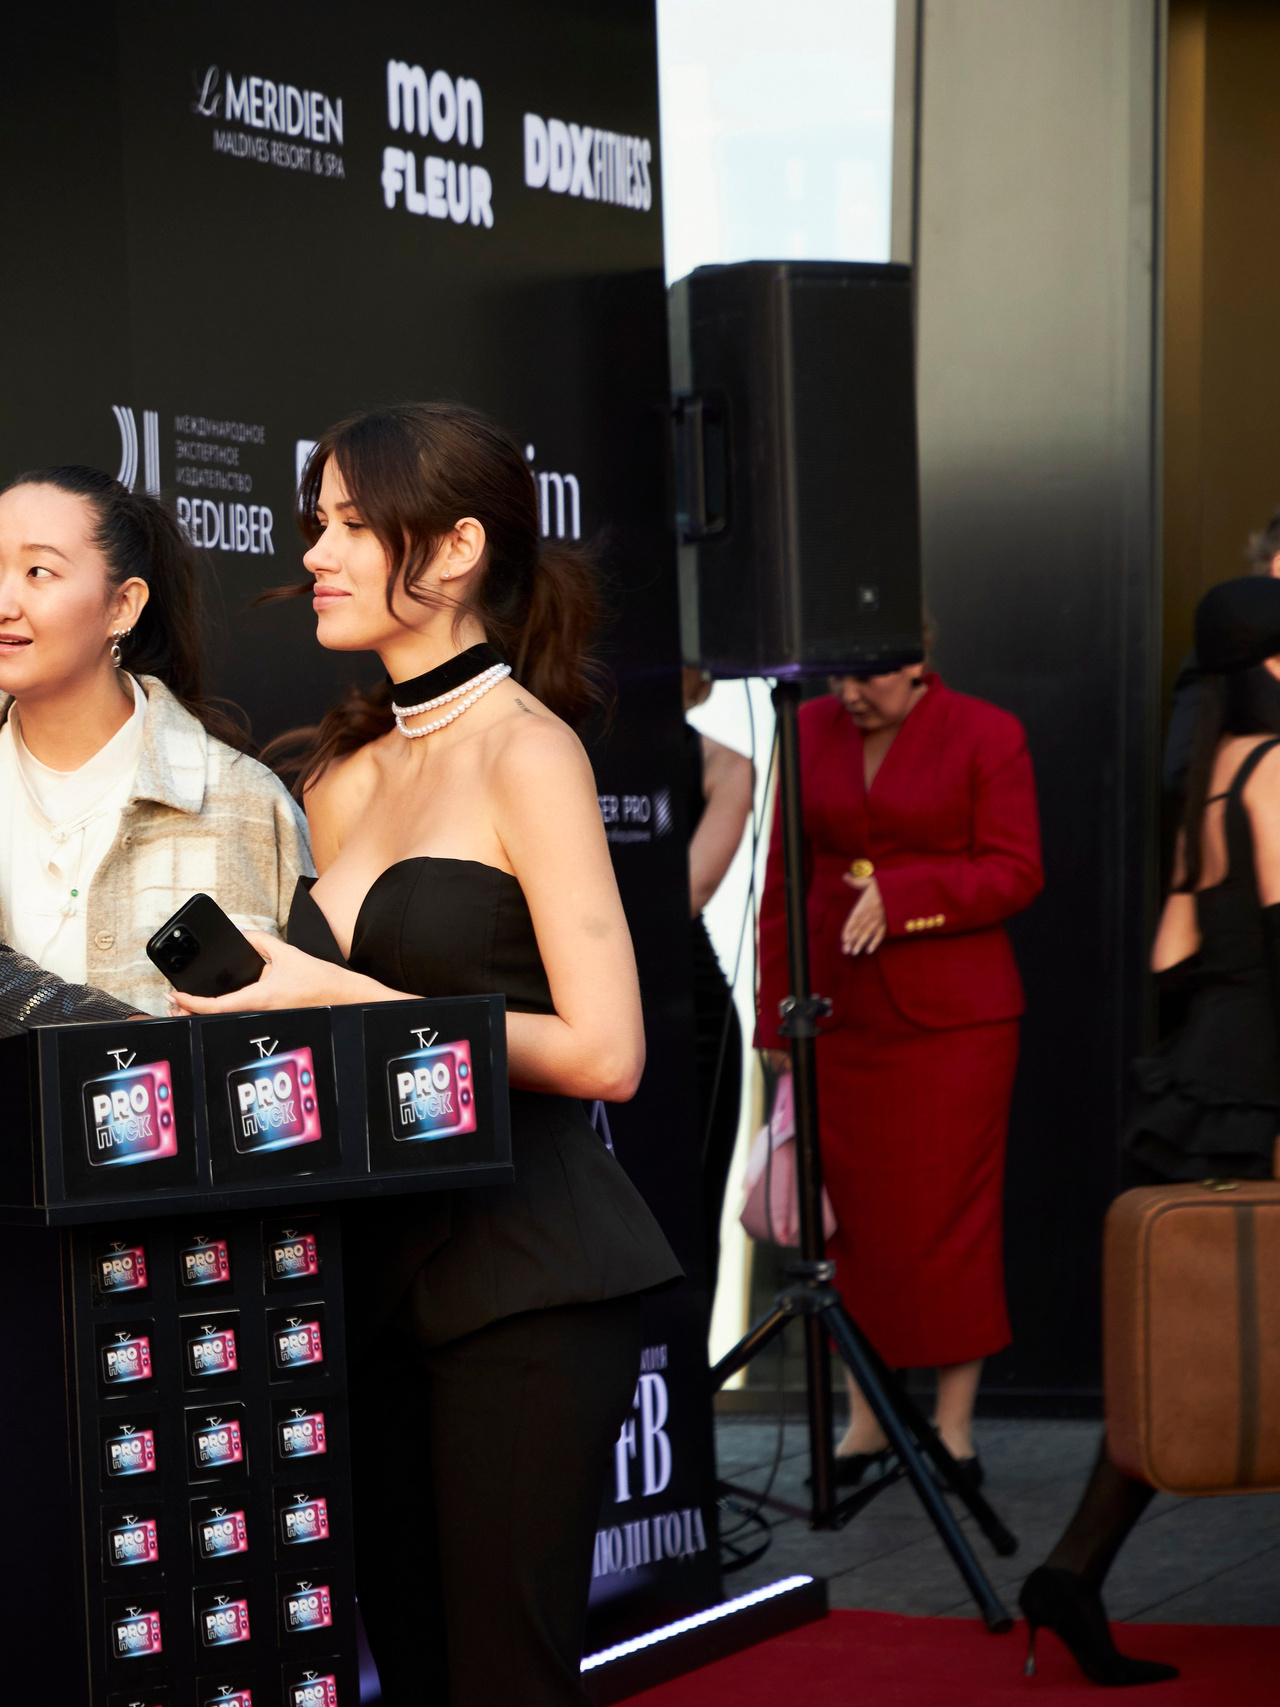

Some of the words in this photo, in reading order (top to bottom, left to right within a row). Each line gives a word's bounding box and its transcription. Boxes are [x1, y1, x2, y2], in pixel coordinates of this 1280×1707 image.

[225, 71, 344, 146] MERIDIEN
[213, 128, 269, 163] MALDIVES
[270, 140, 311, 171] RESORT
[313, 150, 323, 174] &
[324, 152, 345, 180] SPA
[382, 146, 494, 228] FLEUR
[174, 416, 265, 444] МЕЖДУНАРОДНОЕ
[175, 440, 240, 466] ЭКСПЕРТНОЕ
[176, 466, 253, 493] ИЗДАТЕЛЬСТВО
[176, 496, 275, 555] REDLIBER
[622, 795, 651, 823] PRO
[396, 1063, 450, 1100] PRO
[237, 1072, 292, 1111] PRO
[92, 1084, 149, 1124] PRO
[399, 1092, 454, 1125] ПУСК
[242, 1100, 296, 1138] ПУСК
[96, 1119, 152, 1150] ПУСК
[185, 1251, 216, 1267] PRO
[275, 1244, 304, 1261] PRO
[102, 1257, 132, 1273] PRO
[193, 1341, 223, 1357] PRO
[279, 1332, 309, 1349] PRO
[107, 1348, 137, 1364] PRO
[198, 1431, 228, 1449] PRO
[283, 1423, 312, 1440] PRO
[111, 1440, 141, 1457] PRO
[286, 1509, 315, 1526] PRO
[114, 1530, 144, 1547] PRO
[204, 1522, 233, 1540] PRO
[289, 1596, 318, 1614] PRO
[206, 1610, 236, 1628] PRO
[117, 1622, 148, 1640] PRO
[295, 1685, 324, 1703] PRO
